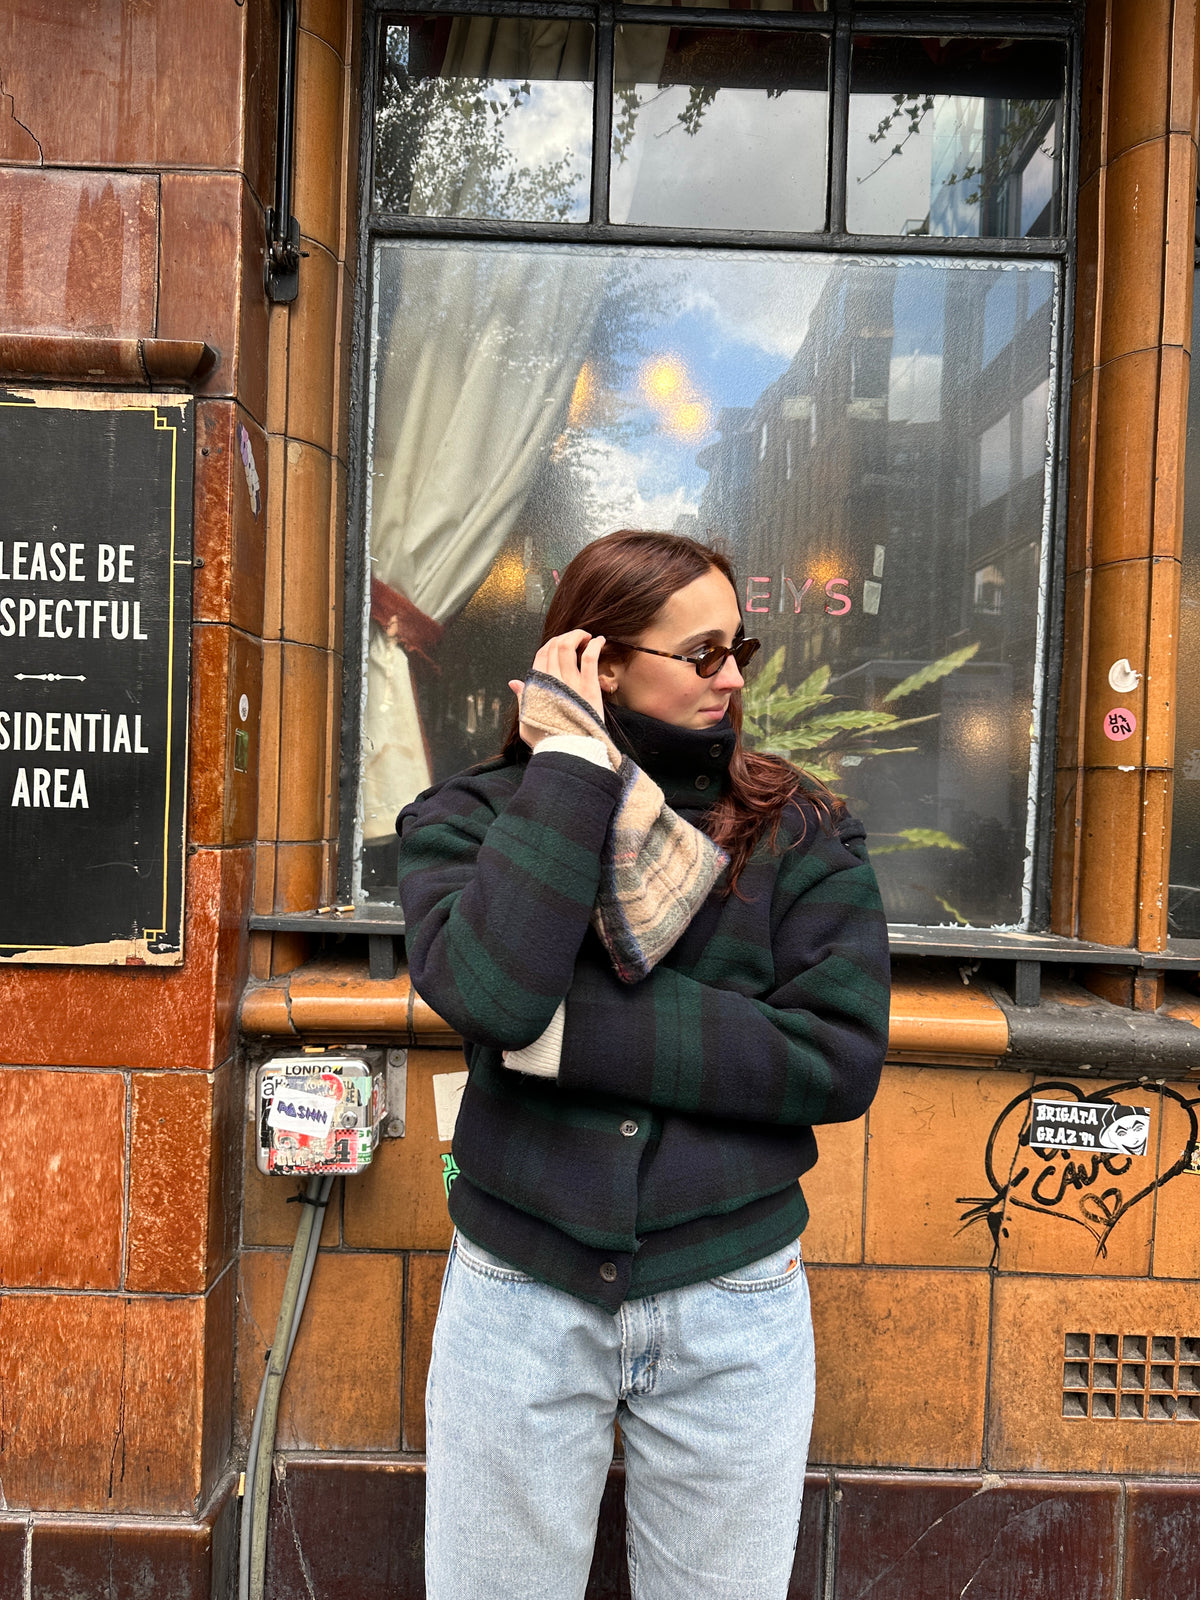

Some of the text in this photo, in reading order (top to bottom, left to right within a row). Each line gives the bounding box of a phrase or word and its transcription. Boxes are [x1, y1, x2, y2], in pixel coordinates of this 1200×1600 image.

[98, 544, 135, 583] BE
[0, 597, 148, 640] SPECTFUL
[11, 767, 89, 809] AREA
[1036, 1104, 1099, 1126] BRIGATA
[1036, 1126, 1077, 1145] GRAZ
